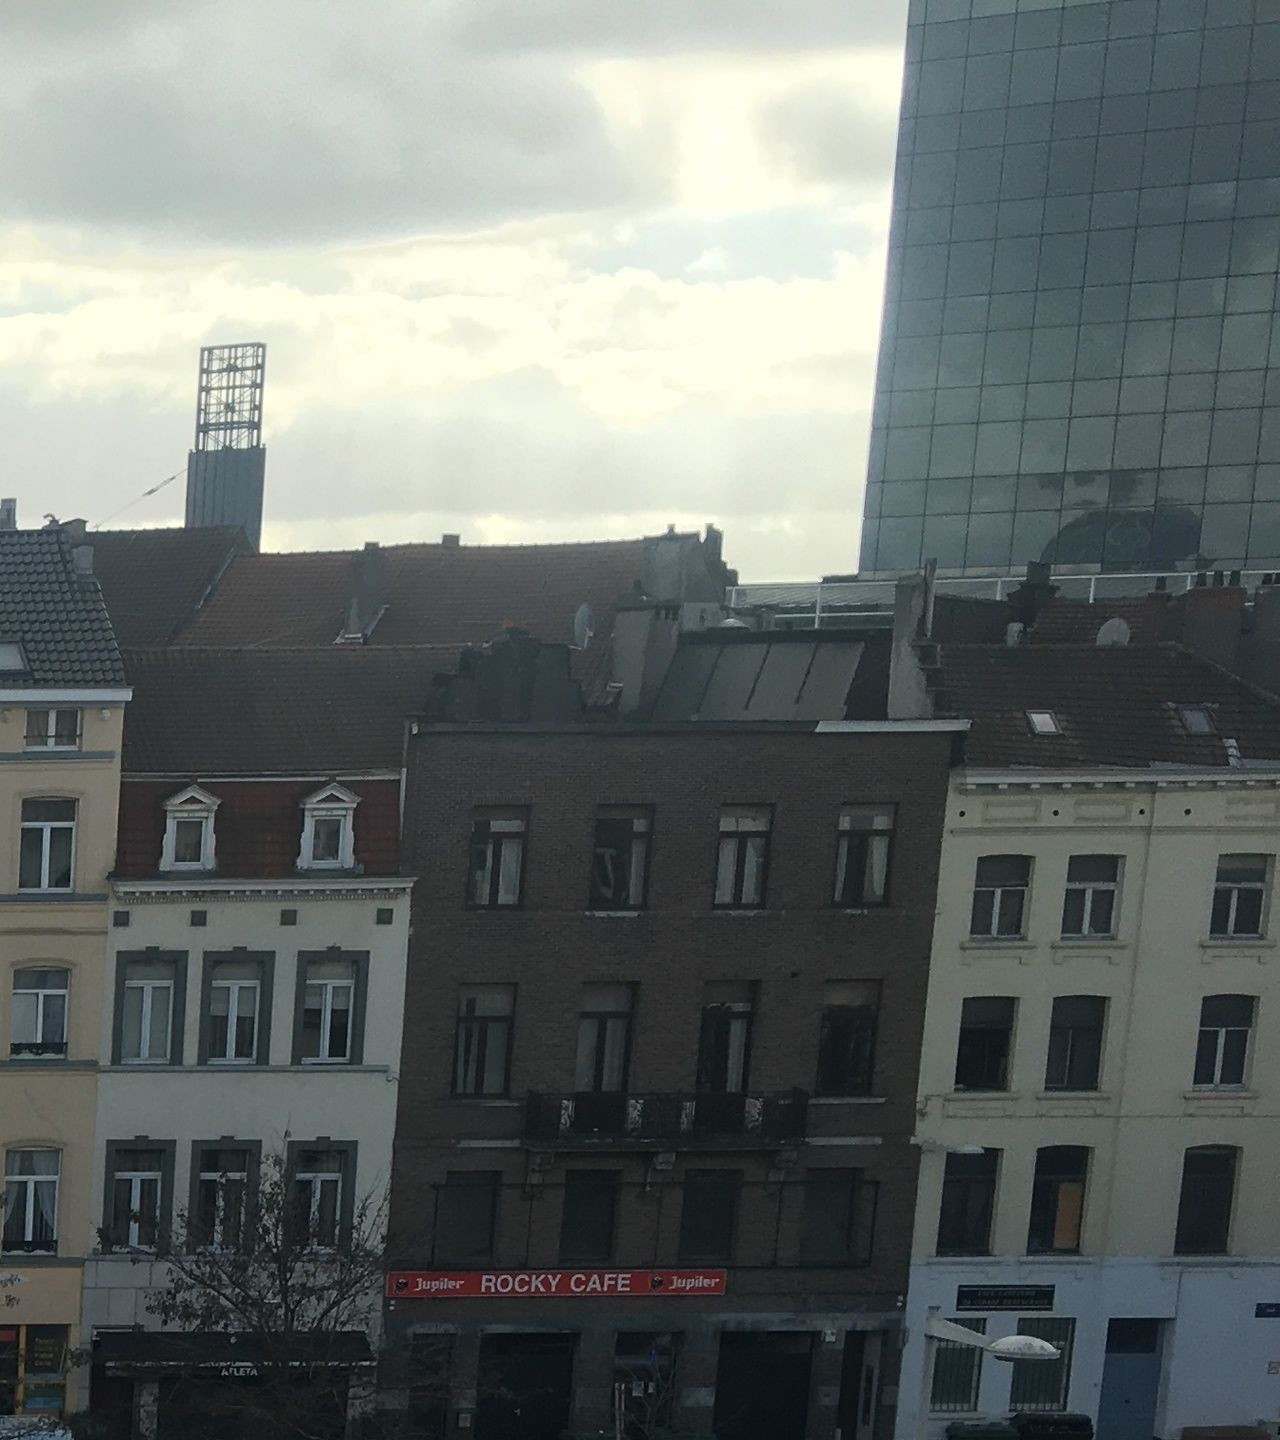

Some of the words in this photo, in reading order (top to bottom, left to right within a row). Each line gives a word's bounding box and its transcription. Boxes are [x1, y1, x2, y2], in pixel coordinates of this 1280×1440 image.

[413, 1277, 464, 1292] Jupiler
[480, 1274, 561, 1293] ROCKY
[570, 1273, 631, 1292] CAFE
[669, 1275, 720, 1291] Jupiler
